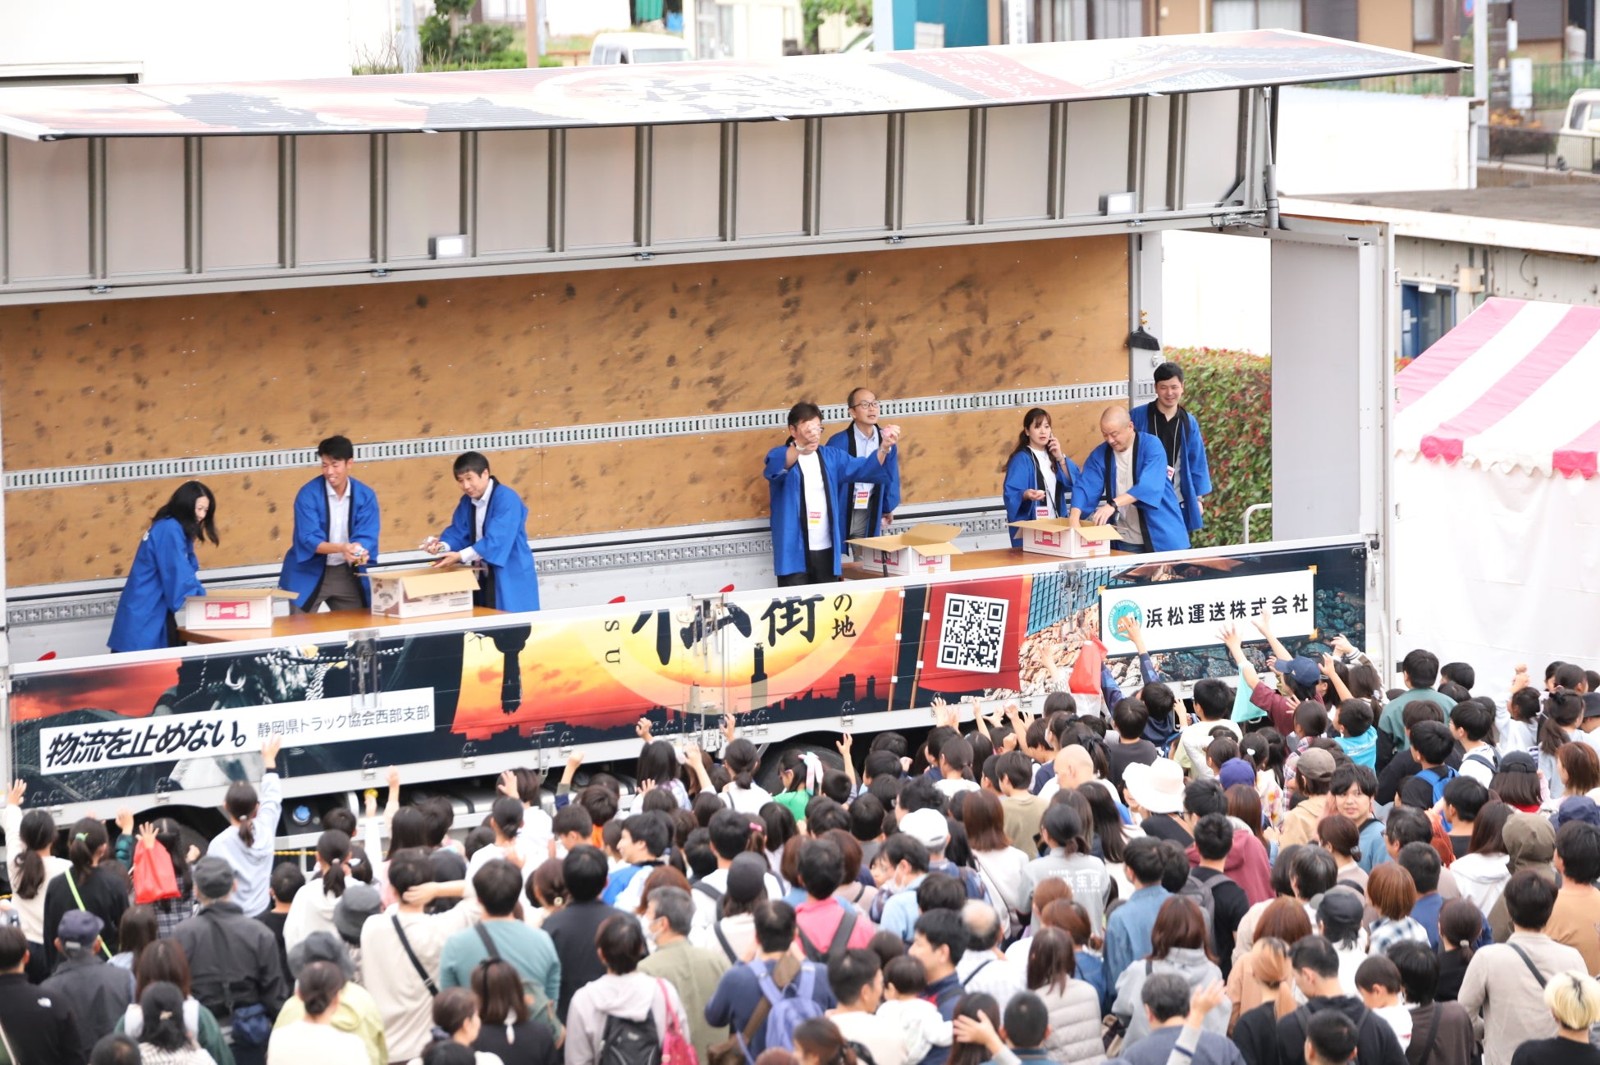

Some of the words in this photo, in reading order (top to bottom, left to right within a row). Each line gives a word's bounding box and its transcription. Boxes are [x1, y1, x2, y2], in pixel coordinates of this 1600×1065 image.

[760, 594, 825, 647] 街
[831, 594, 857, 640] の地
[1146, 594, 1309, 628] 浜松運送株式会社
[46, 719, 246, 768] 物流を止めない。
[257, 704, 430, 738] 静岡県トラック協会西部支部
